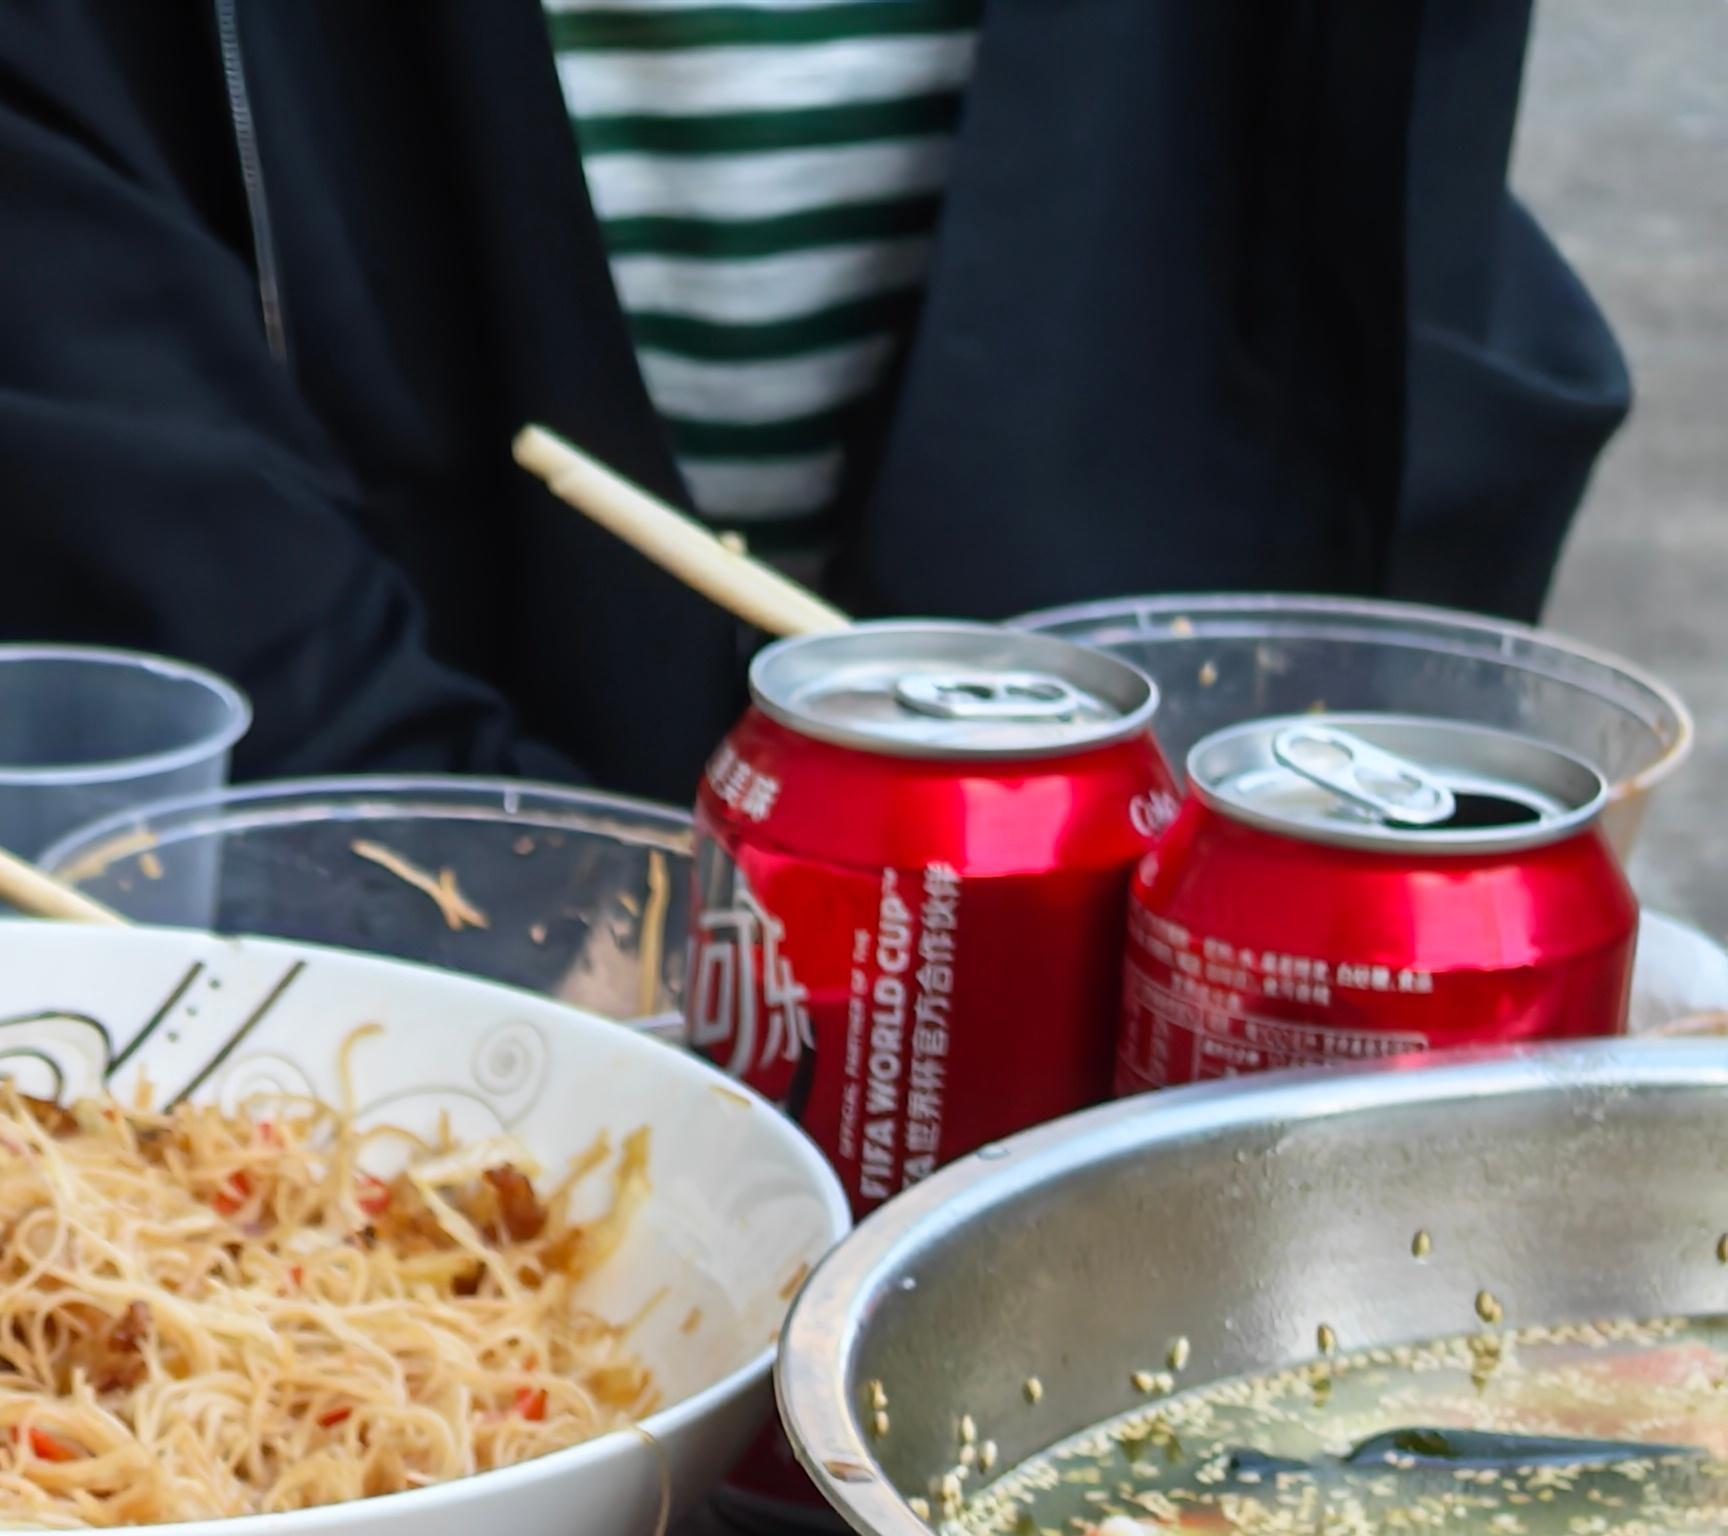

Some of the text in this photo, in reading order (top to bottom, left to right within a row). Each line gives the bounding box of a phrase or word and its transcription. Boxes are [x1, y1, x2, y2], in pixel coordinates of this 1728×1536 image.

[688, 886, 817, 1077] 可乐
[865, 976, 909, 1114] WORLD
[859, 1118, 900, 1200] FIFA
